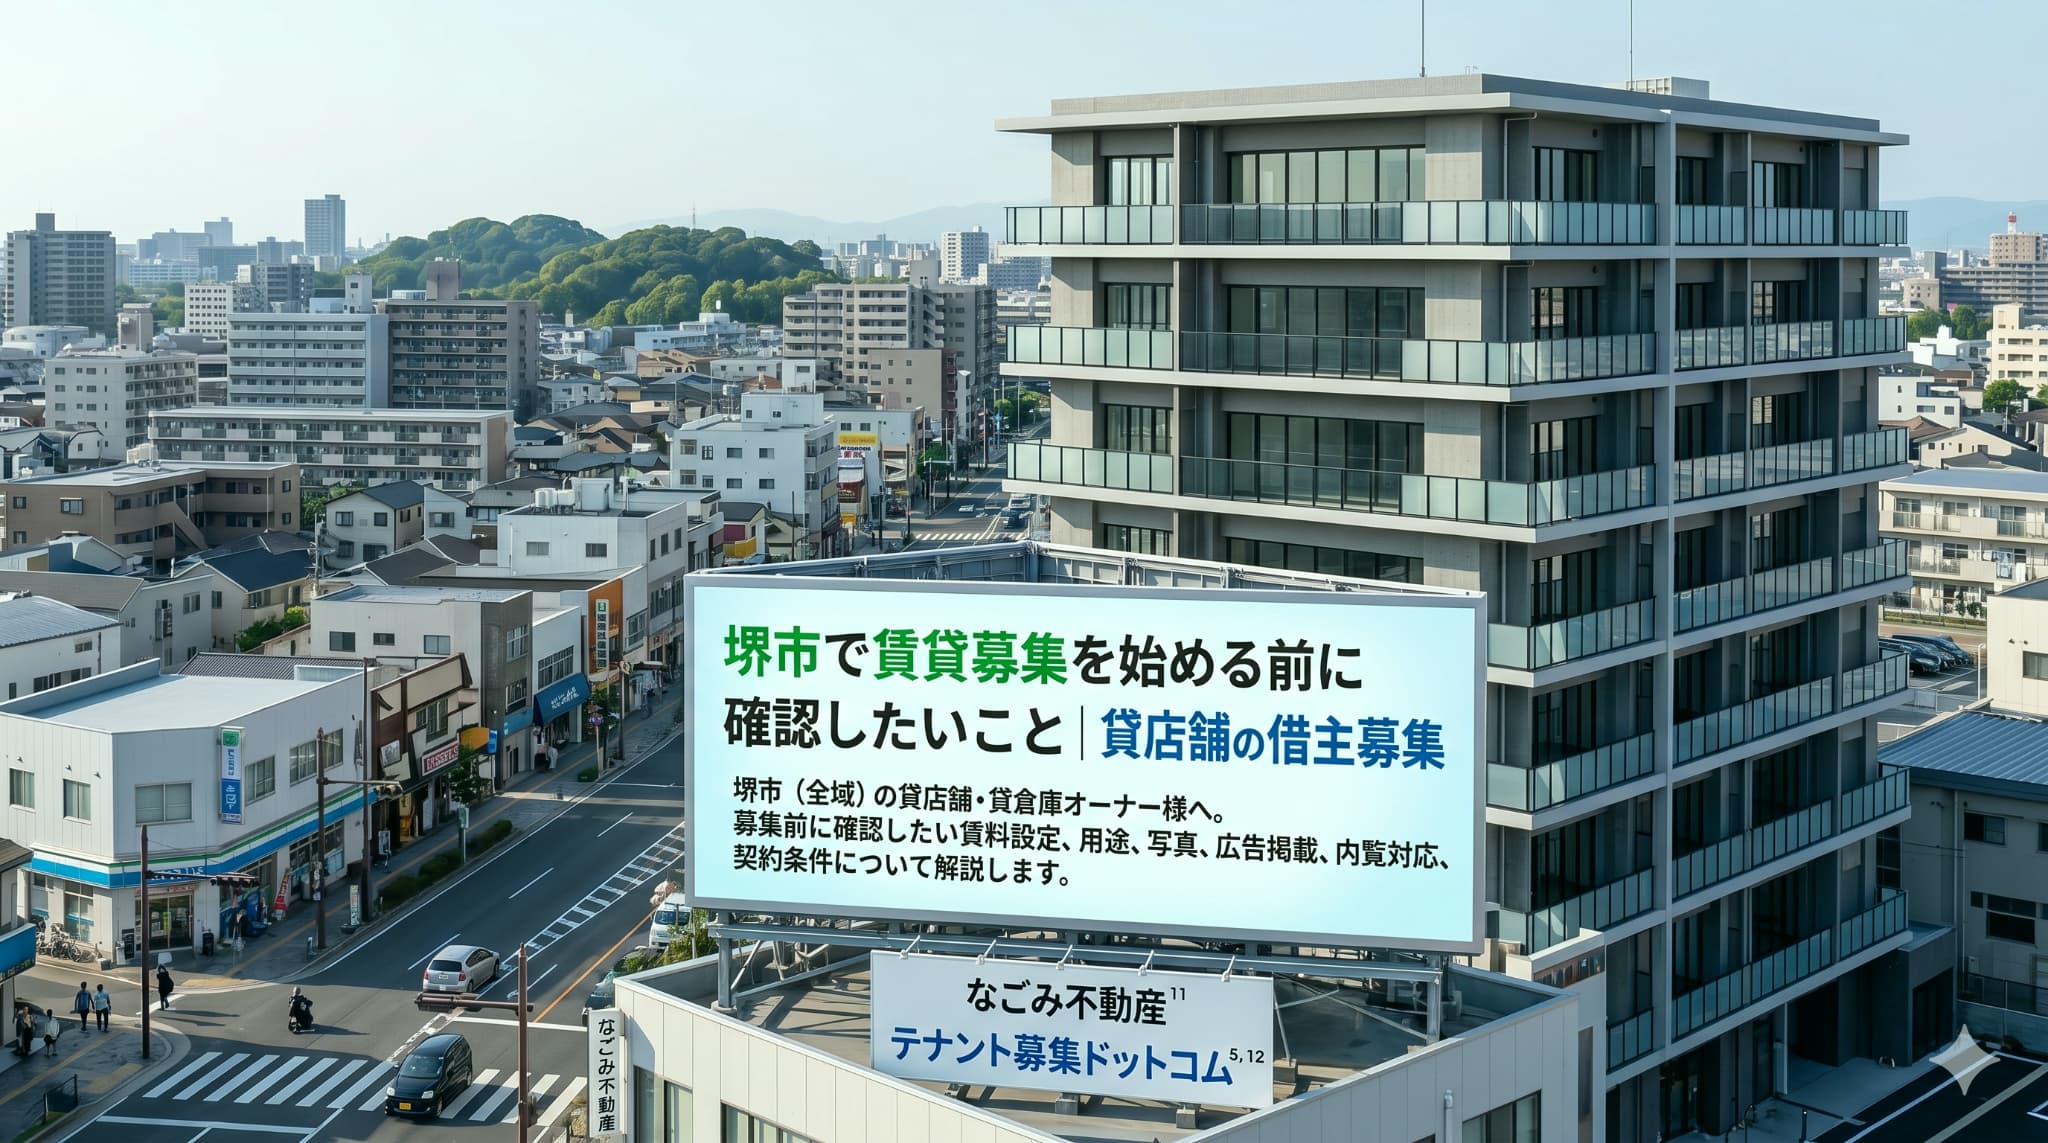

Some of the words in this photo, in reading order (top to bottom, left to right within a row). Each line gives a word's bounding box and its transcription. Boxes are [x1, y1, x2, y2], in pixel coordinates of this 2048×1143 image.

[723, 623, 1362, 692] 堺市で賃貸募集を始める前に
[733, 843, 1069, 887] 契約条件について解説します。
[598, 1018, 616, 1133] なごみ不動産
